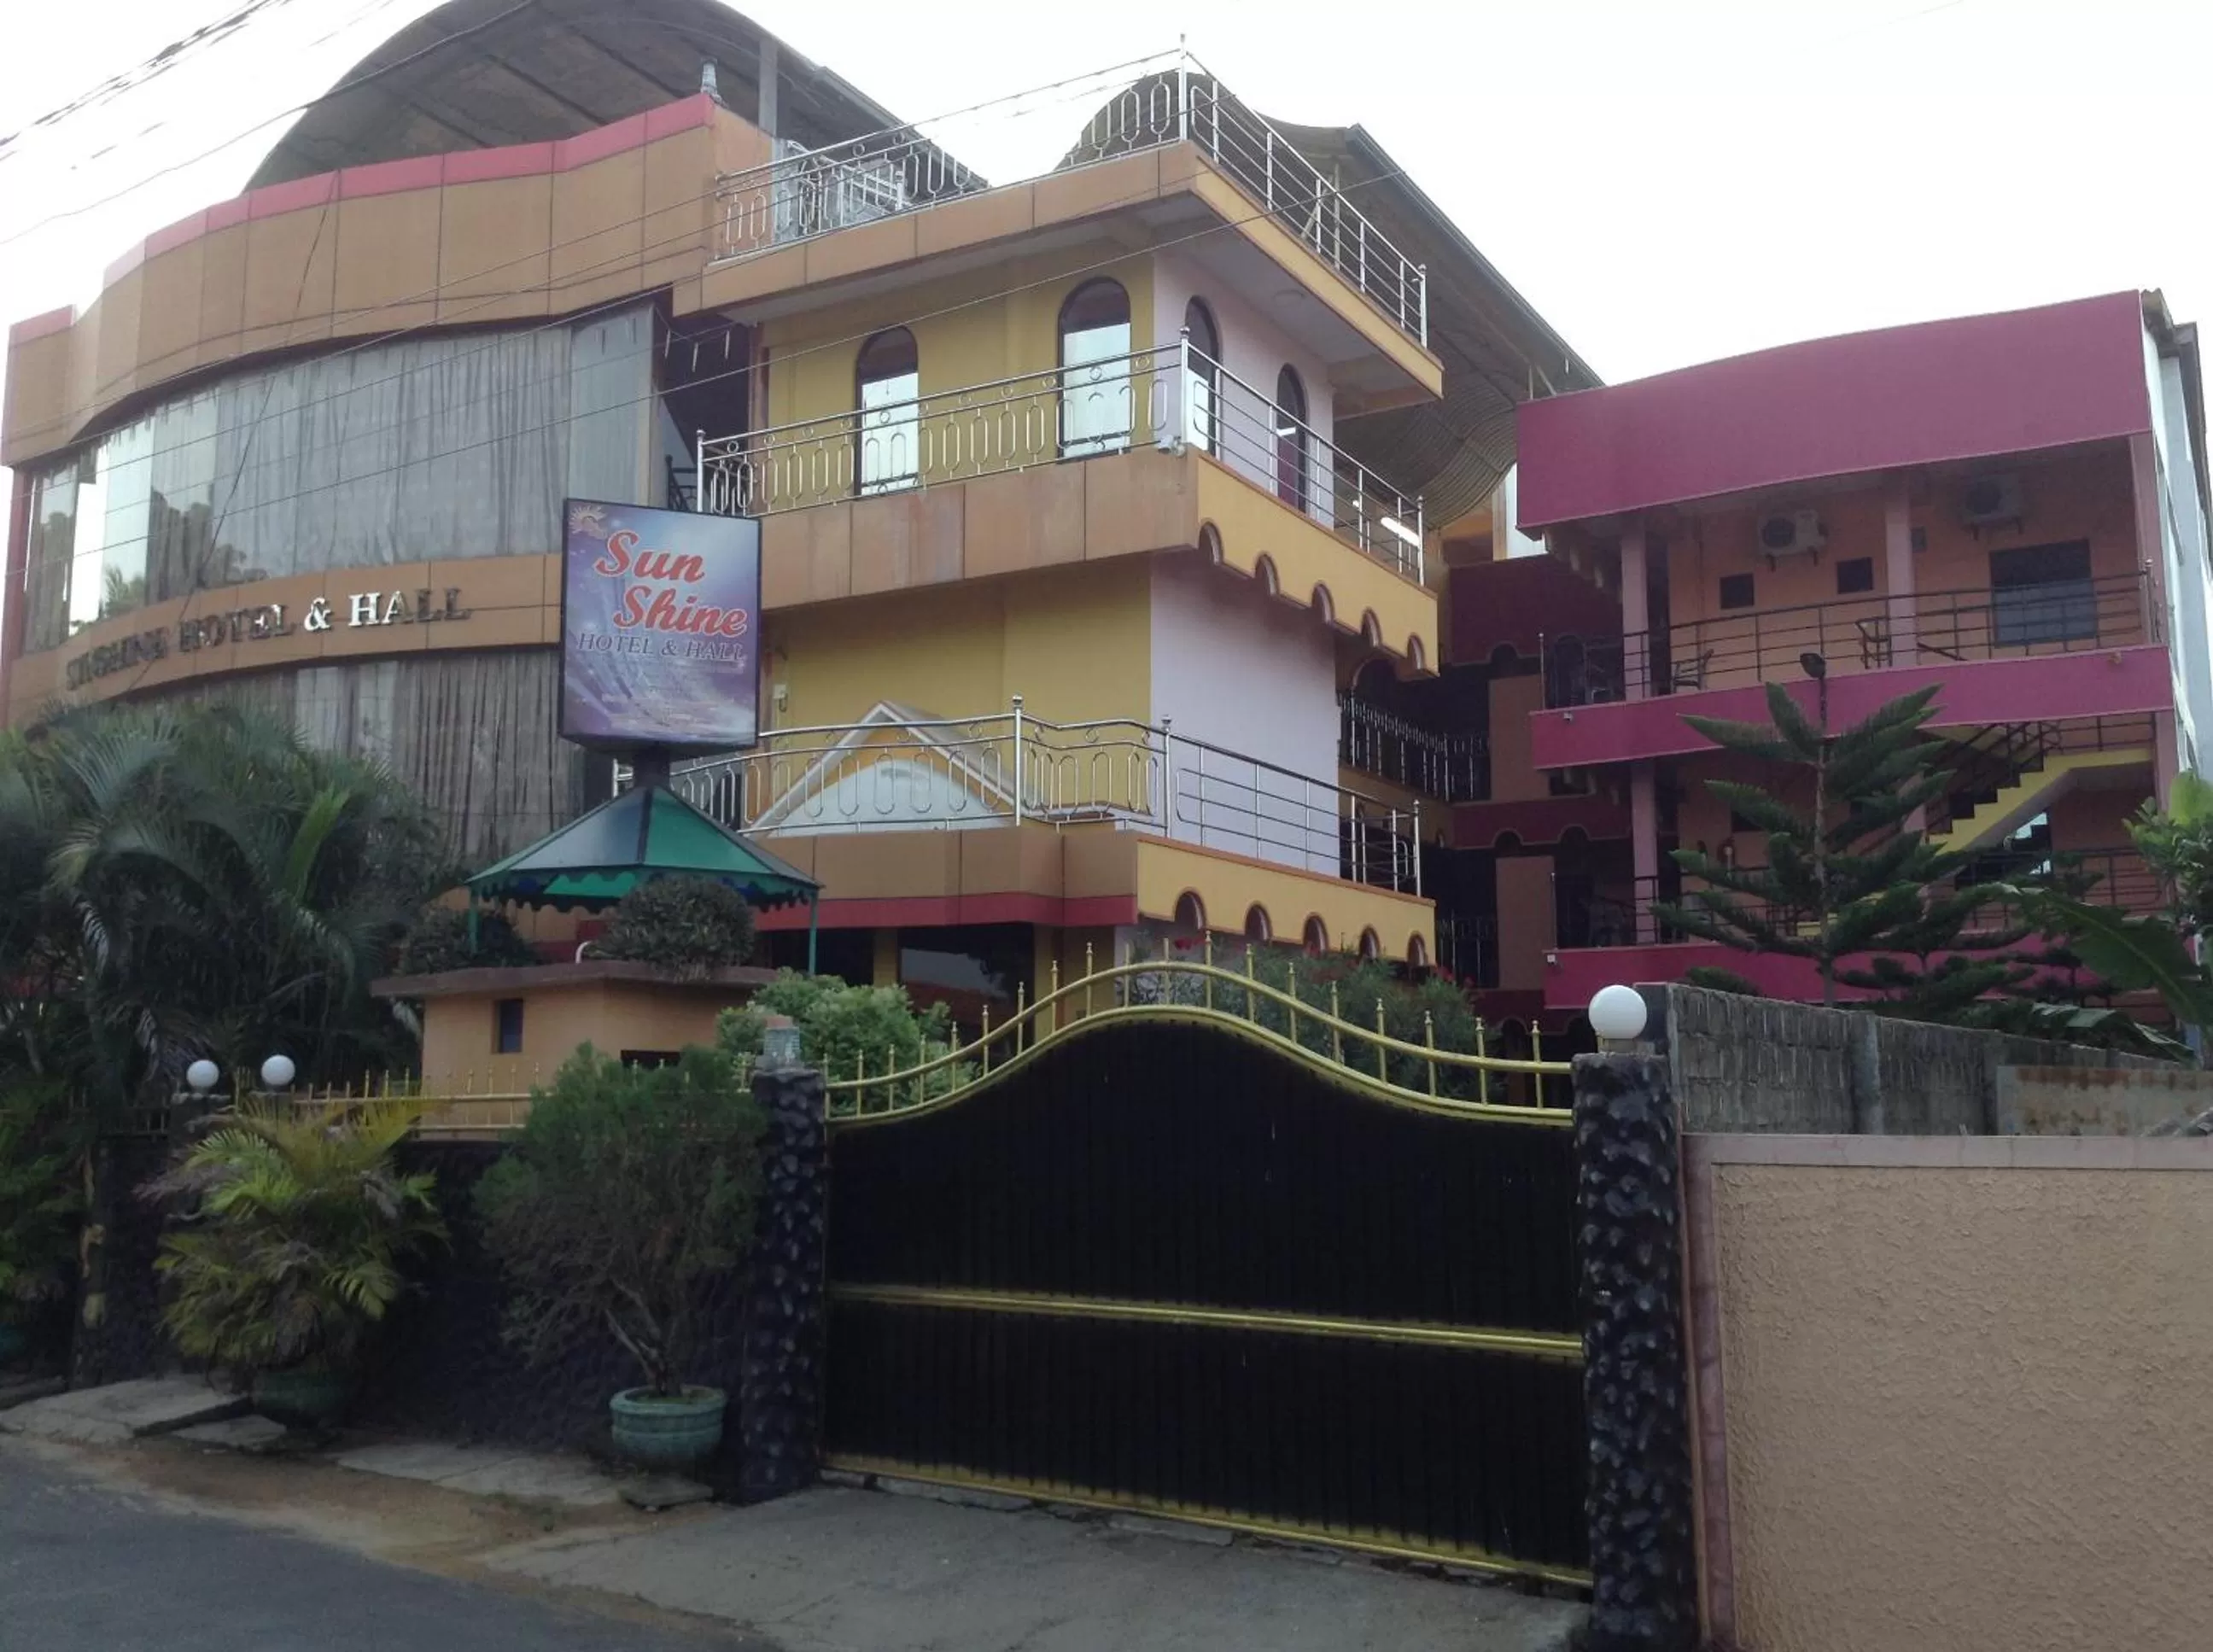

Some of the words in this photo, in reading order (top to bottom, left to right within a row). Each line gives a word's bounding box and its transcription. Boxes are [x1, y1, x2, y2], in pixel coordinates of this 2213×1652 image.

[595, 529, 705, 583] Sun
[179, 604, 296, 652] HOTEL
[304, 597, 332, 631] &
[347, 589, 472, 627] HALL
[613, 585, 747, 637] Shine
[578, 633, 653, 655] HOTEL
[661, 640, 677, 657] &
[686, 641, 745, 661] HALL
